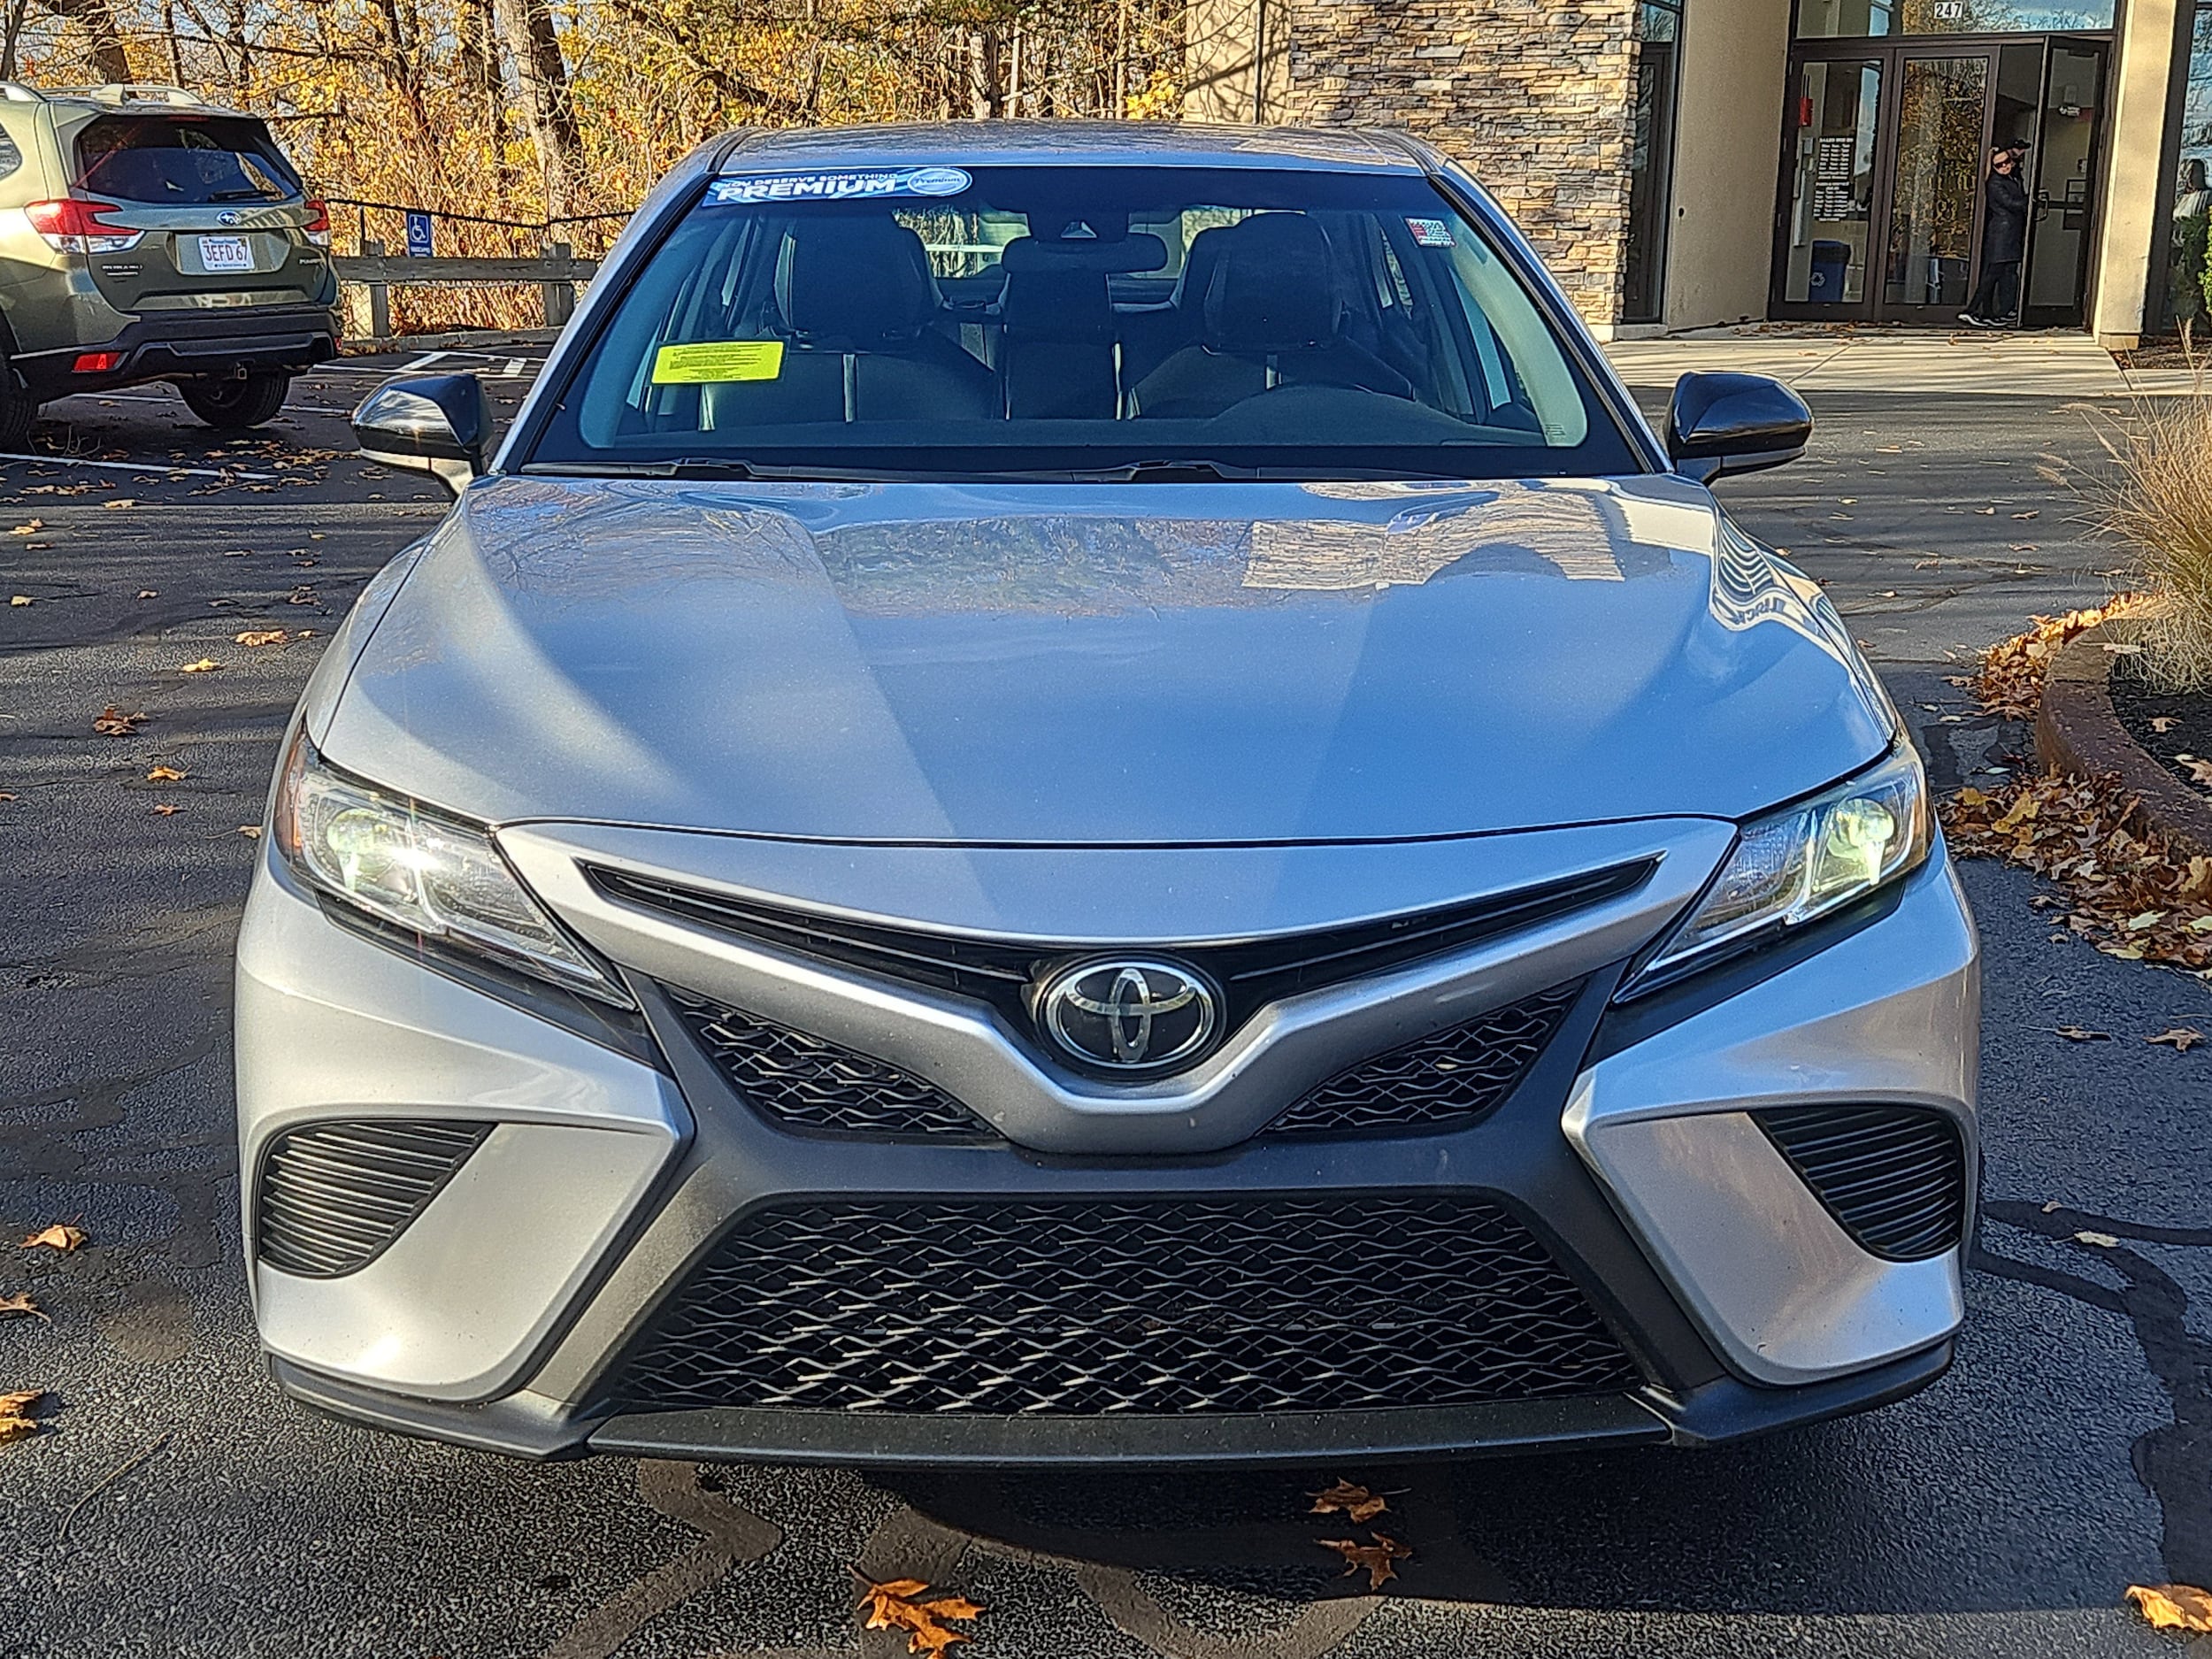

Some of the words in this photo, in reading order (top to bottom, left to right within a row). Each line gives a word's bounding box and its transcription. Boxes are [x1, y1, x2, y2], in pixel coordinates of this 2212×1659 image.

[1936, 3, 1962, 18] 247
[754, 176, 816, 185] DESERVE
[819, 173, 898, 181] SOMETHING
[717, 179, 897, 201] PREMIUM
[203, 244, 234, 262] 3EFD
